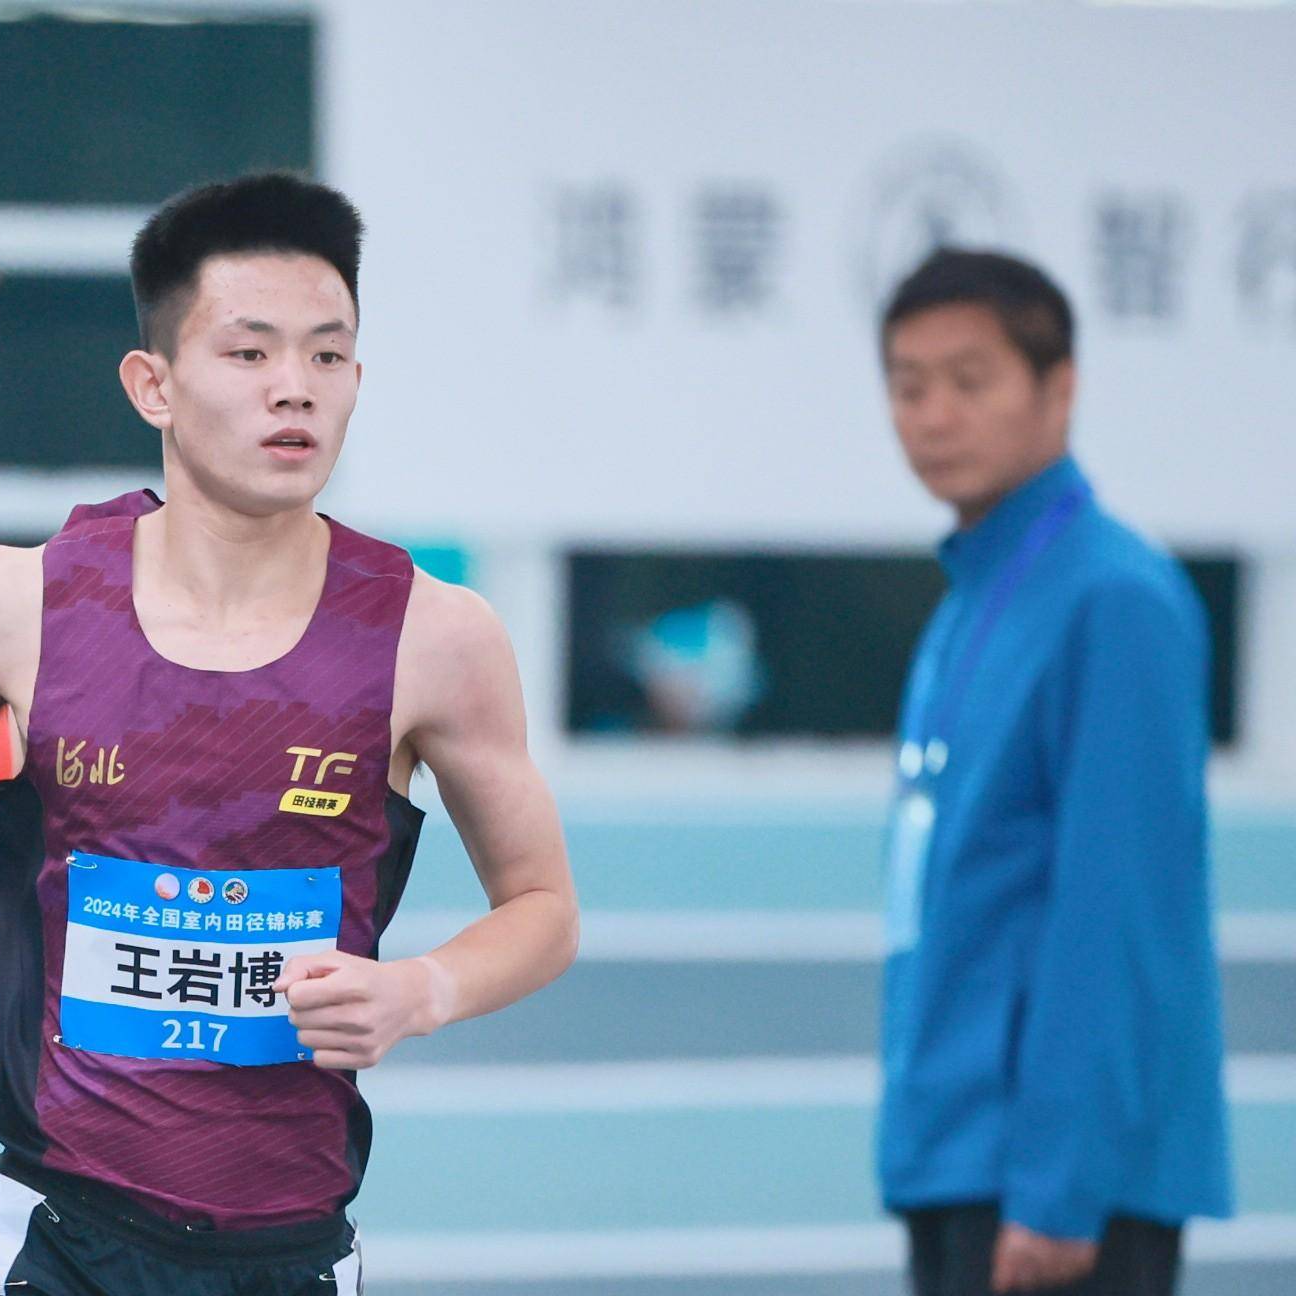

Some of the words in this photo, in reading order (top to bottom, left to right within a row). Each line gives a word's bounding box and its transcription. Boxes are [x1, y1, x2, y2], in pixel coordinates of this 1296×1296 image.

[285, 745, 358, 785] TF
[292, 794, 339, 811] 田径精英
[83, 896, 324, 933] 2024年全国室内田径锦标赛
[110, 942, 284, 1008] 王岩博
[161, 1019, 228, 1052] 217
